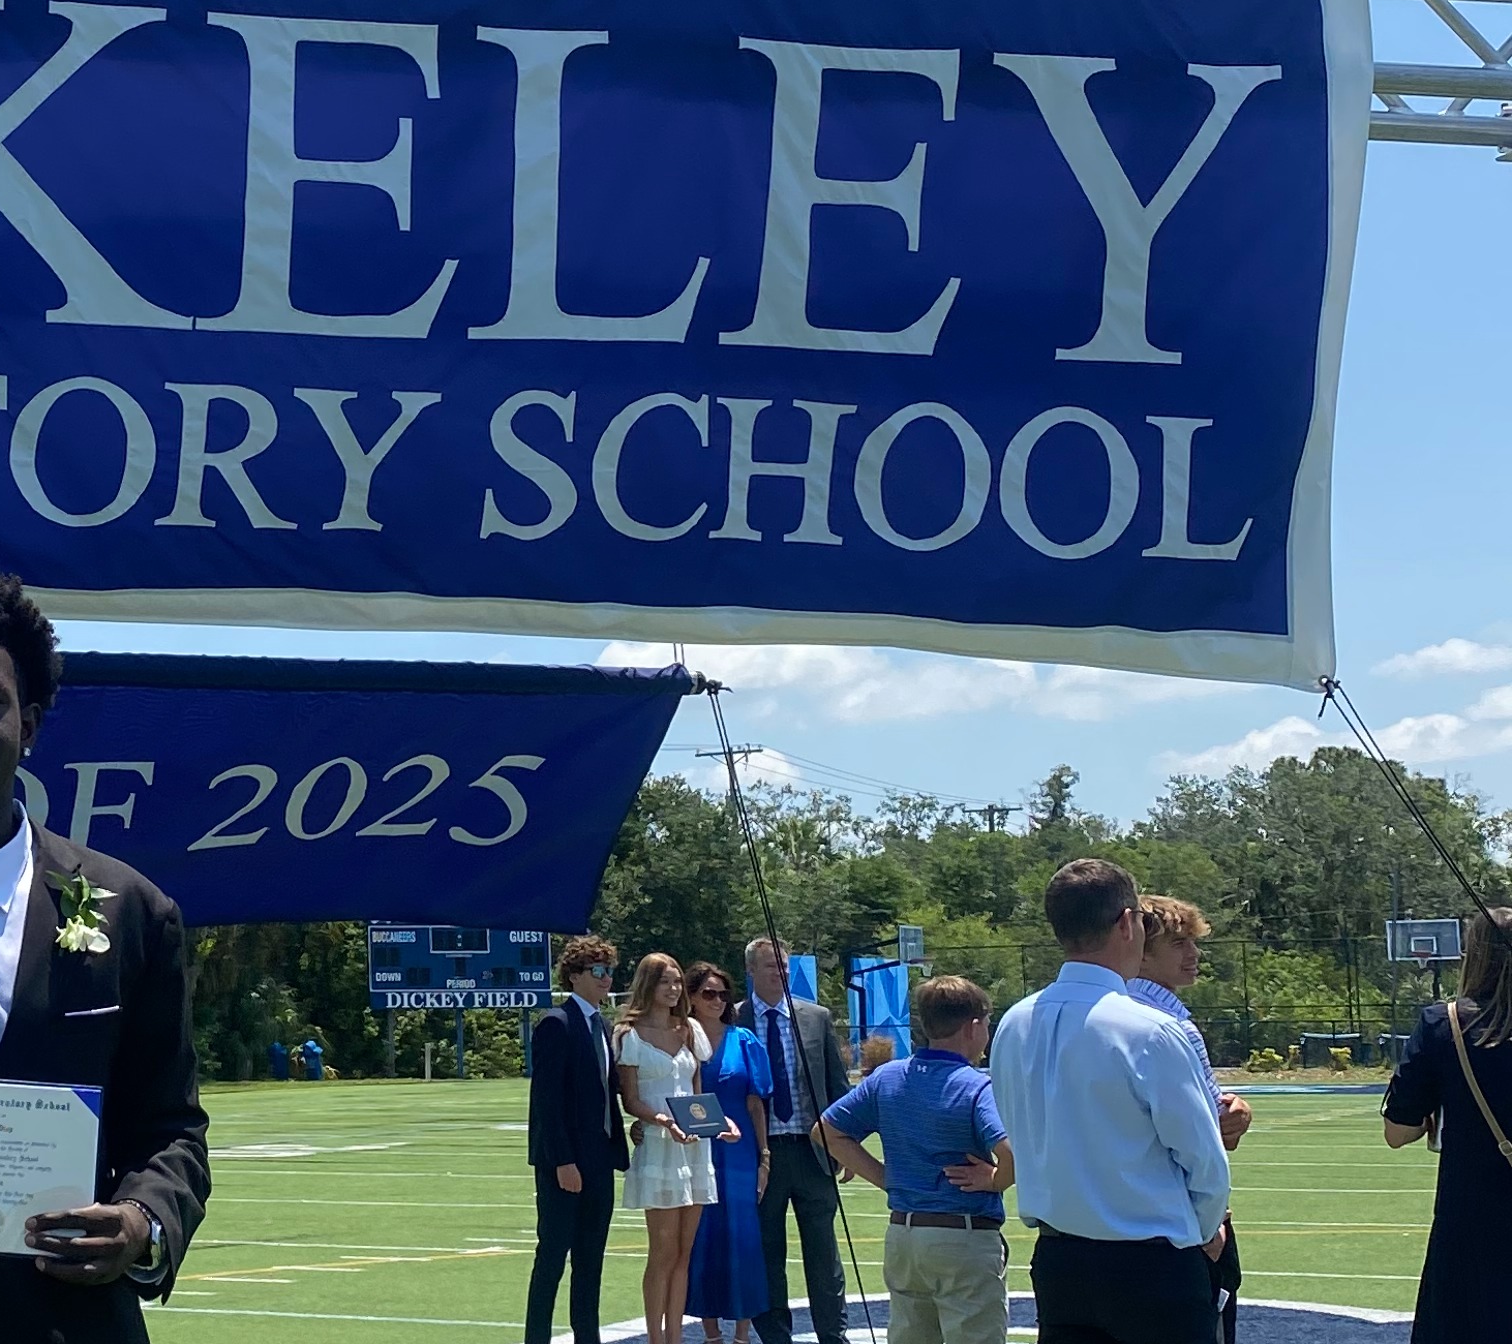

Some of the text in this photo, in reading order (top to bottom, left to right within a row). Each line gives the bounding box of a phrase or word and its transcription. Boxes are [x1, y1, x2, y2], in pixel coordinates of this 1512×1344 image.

[480, 390, 1253, 561] SCHOOL
[187, 755, 545, 851] 2025
[372, 931, 416, 943] BUCCANEERS
[509, 931, 544, 943] GUEST
[375, 972, 402, 982] DOWN
[519, 972, 544, 981] TO GO
[447, 979, 476, 989] PERIOD
[386, 992, 538, 1008] DICKEY FIELD
